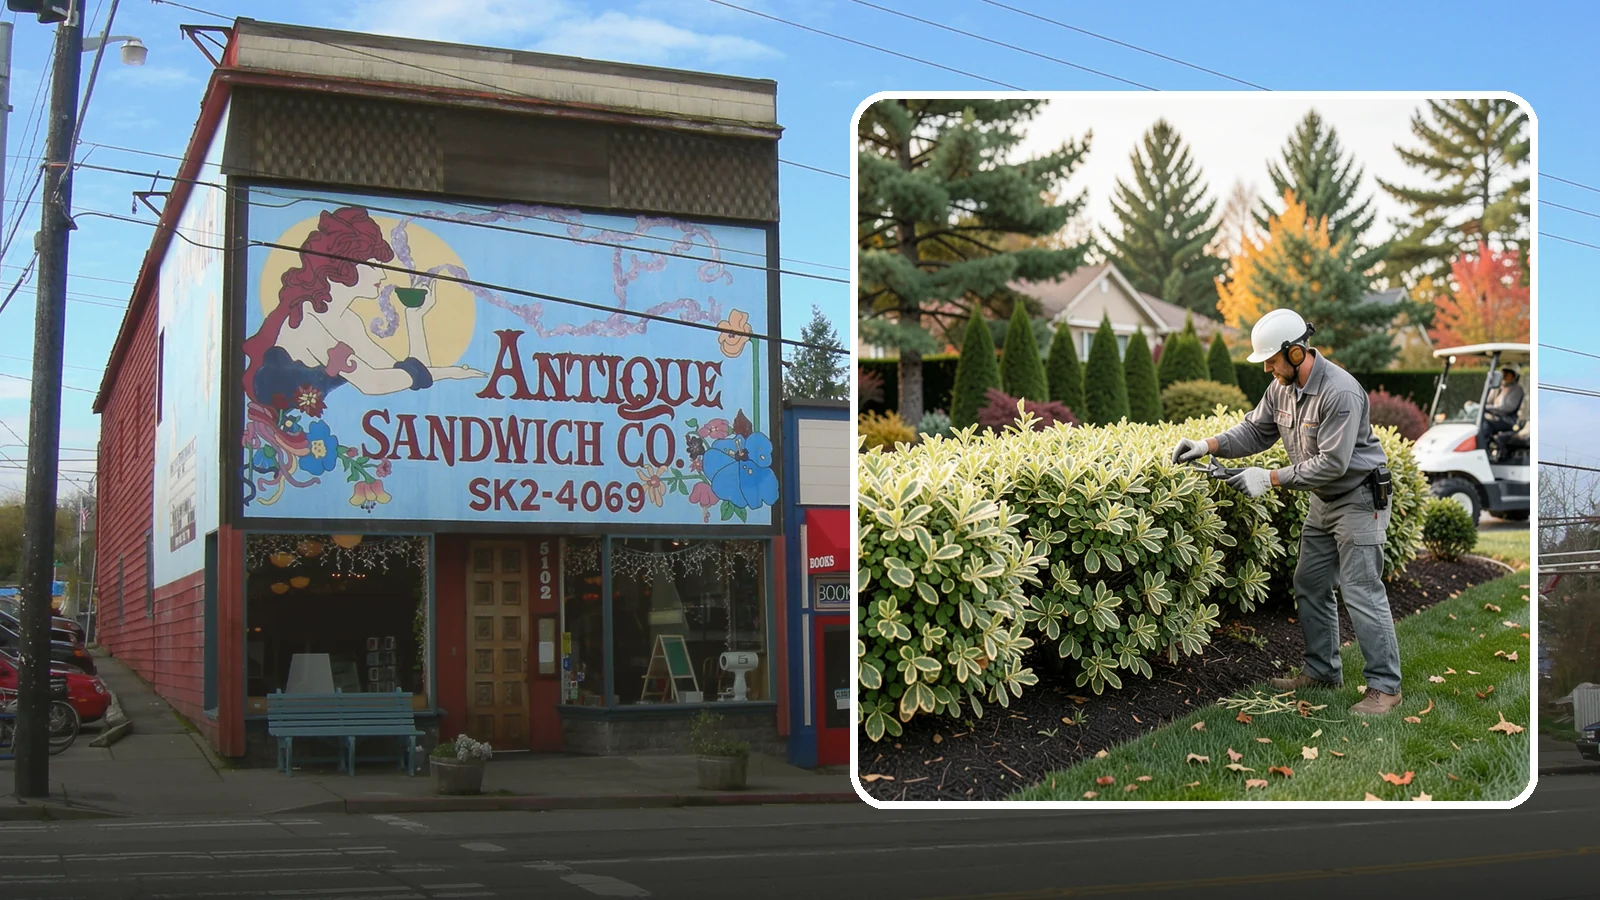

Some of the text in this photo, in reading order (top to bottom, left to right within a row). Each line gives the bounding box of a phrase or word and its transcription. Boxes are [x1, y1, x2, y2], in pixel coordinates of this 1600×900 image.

[475, 329, 723, 421] ANTIQUE
[361, 408, 685, 469] SANDWICH CO.
[468, 477, 645, 513] SK2-4069
[540, 541, 552, 600] 5102
[809, 555, 835, 569] BOOKS
